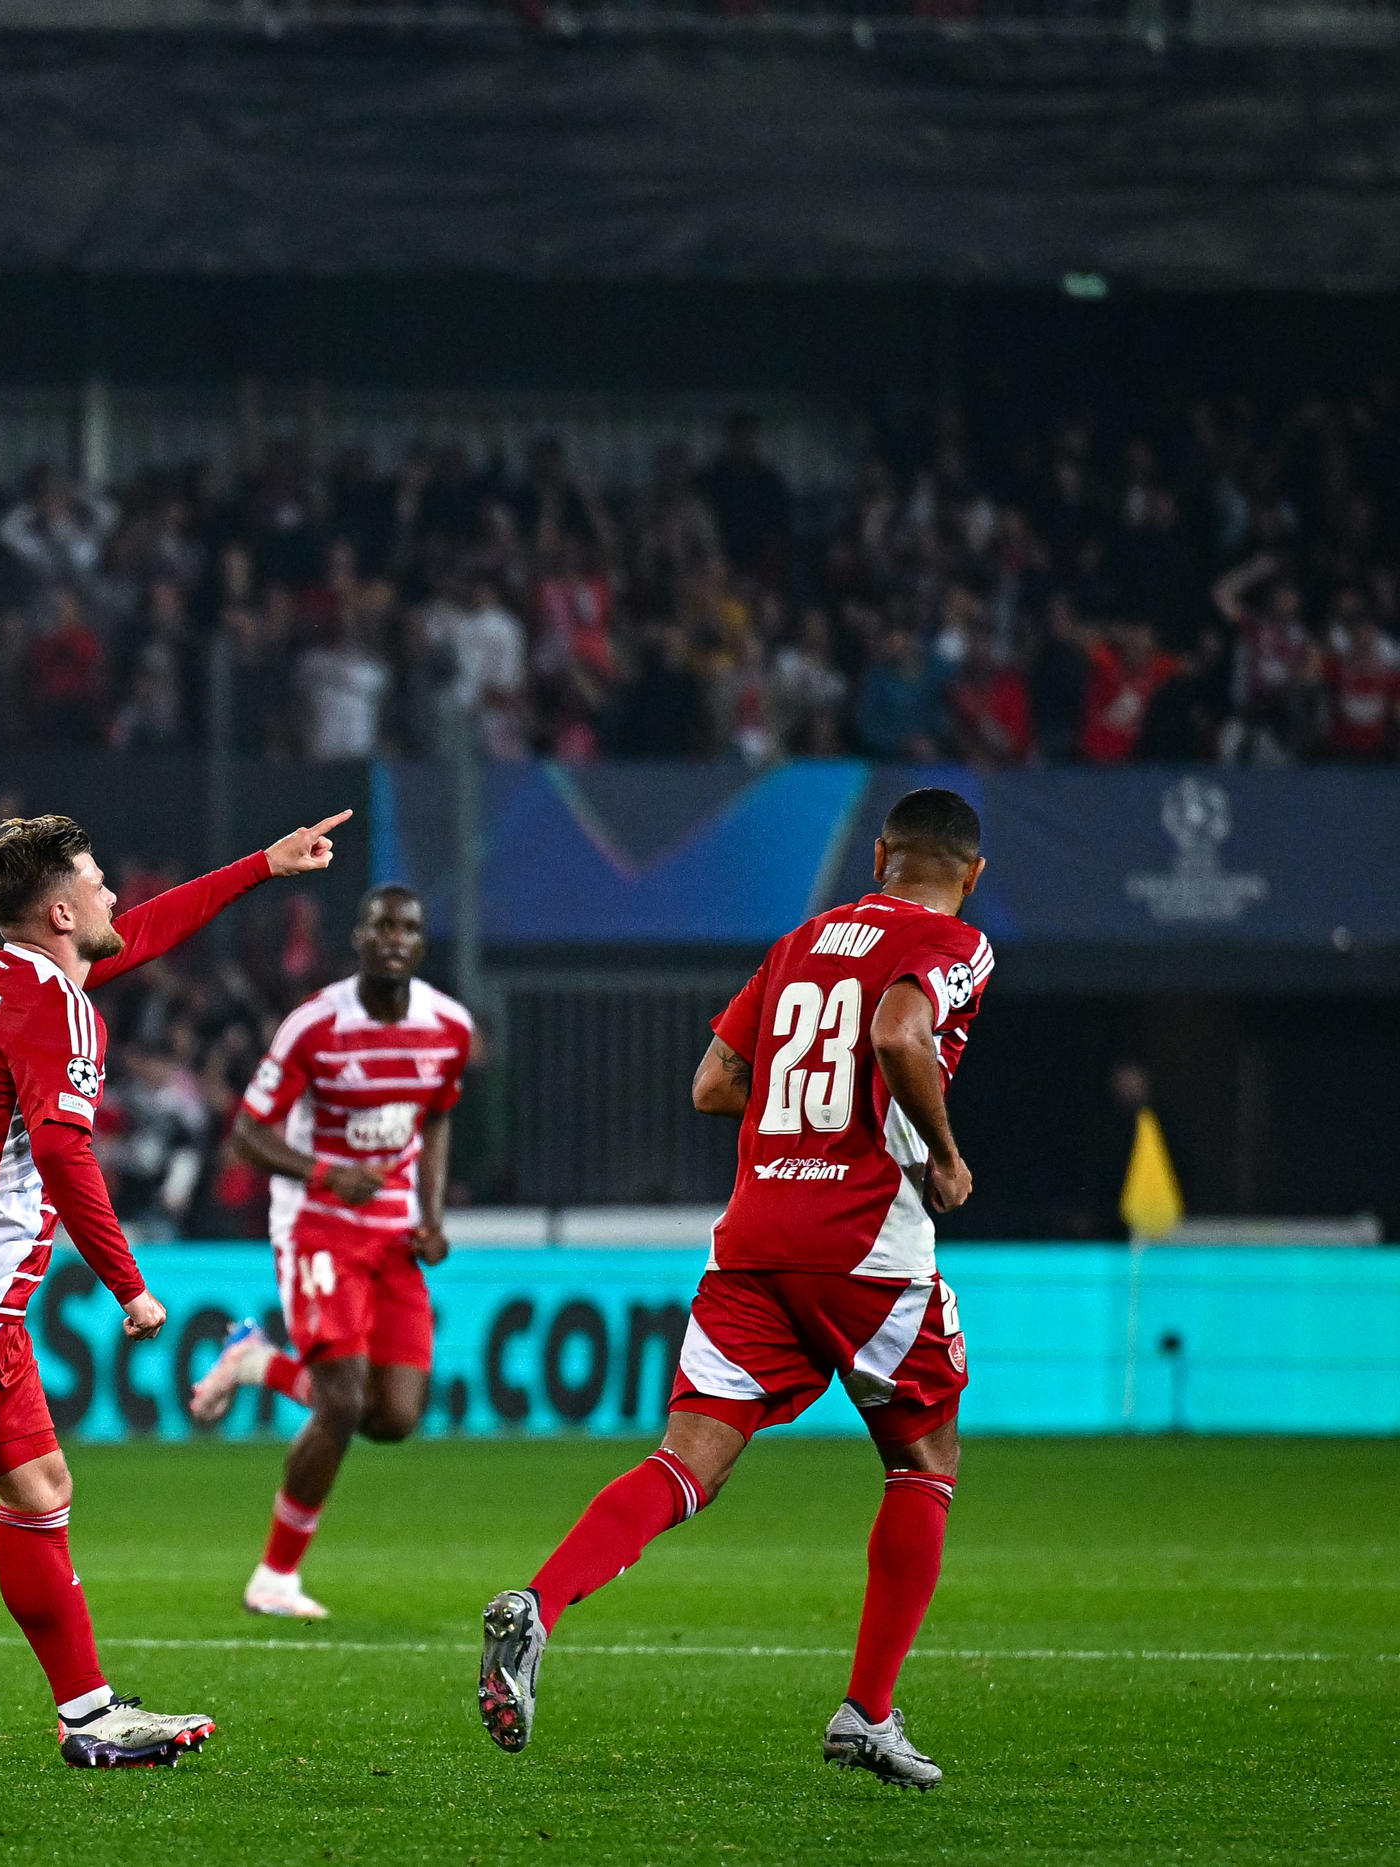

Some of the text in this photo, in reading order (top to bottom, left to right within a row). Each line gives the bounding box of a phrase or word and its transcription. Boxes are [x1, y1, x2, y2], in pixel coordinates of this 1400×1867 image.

[809, 922, 886, 958] AMAVI
[758, 977, 862, 1135] 23
[776, 1166, 798, 1180] LE
[783, 1157, 823, 1167] FONDS
